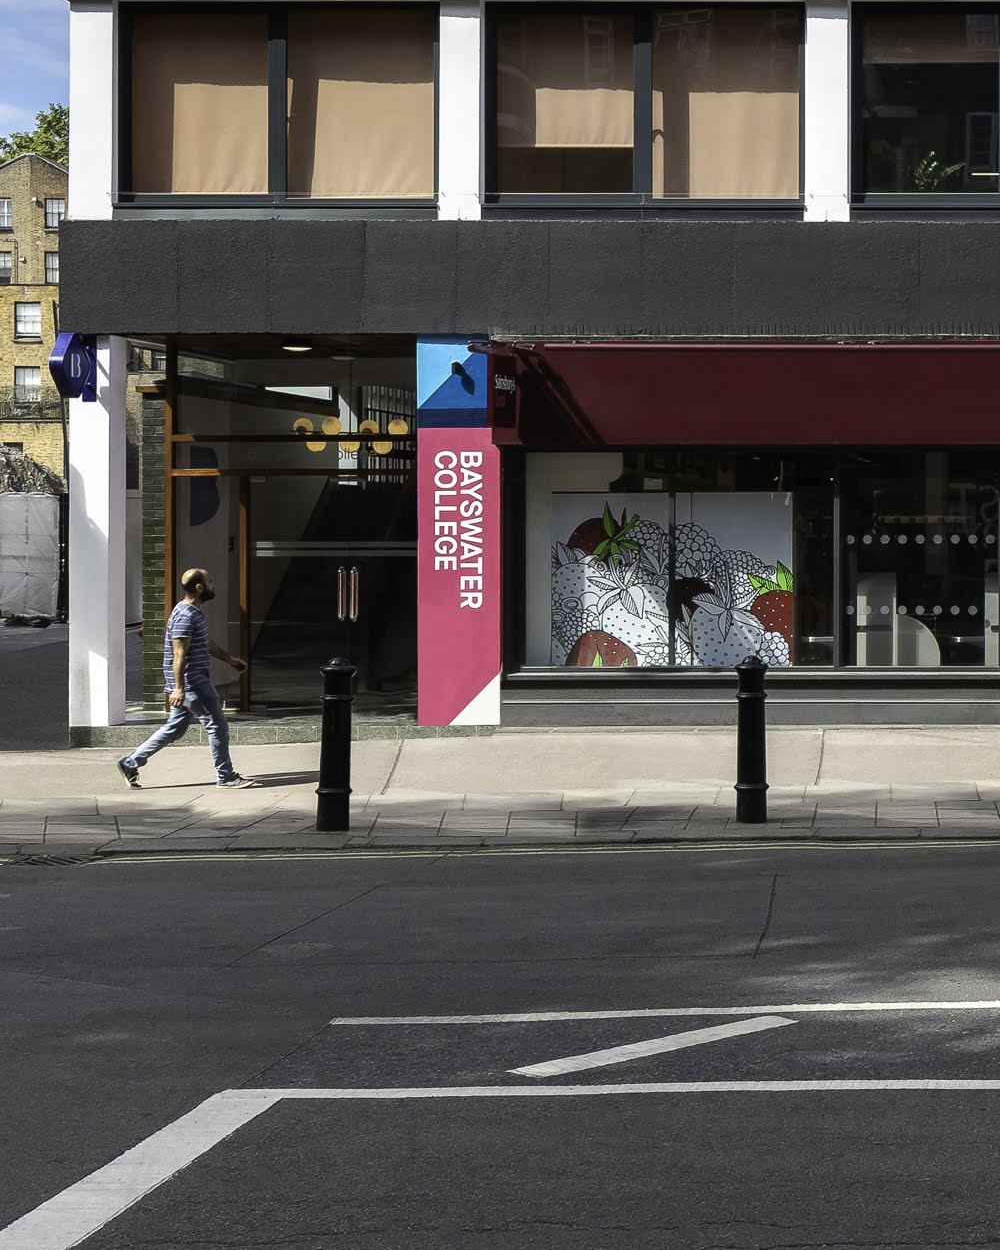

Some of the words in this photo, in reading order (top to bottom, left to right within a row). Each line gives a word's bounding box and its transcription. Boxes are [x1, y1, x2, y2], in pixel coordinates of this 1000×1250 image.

[71, 353, 82, 378] B
[433, 450, 458, 571] COLLEGE
[459, 451, 484, 609] BAYSWATER
